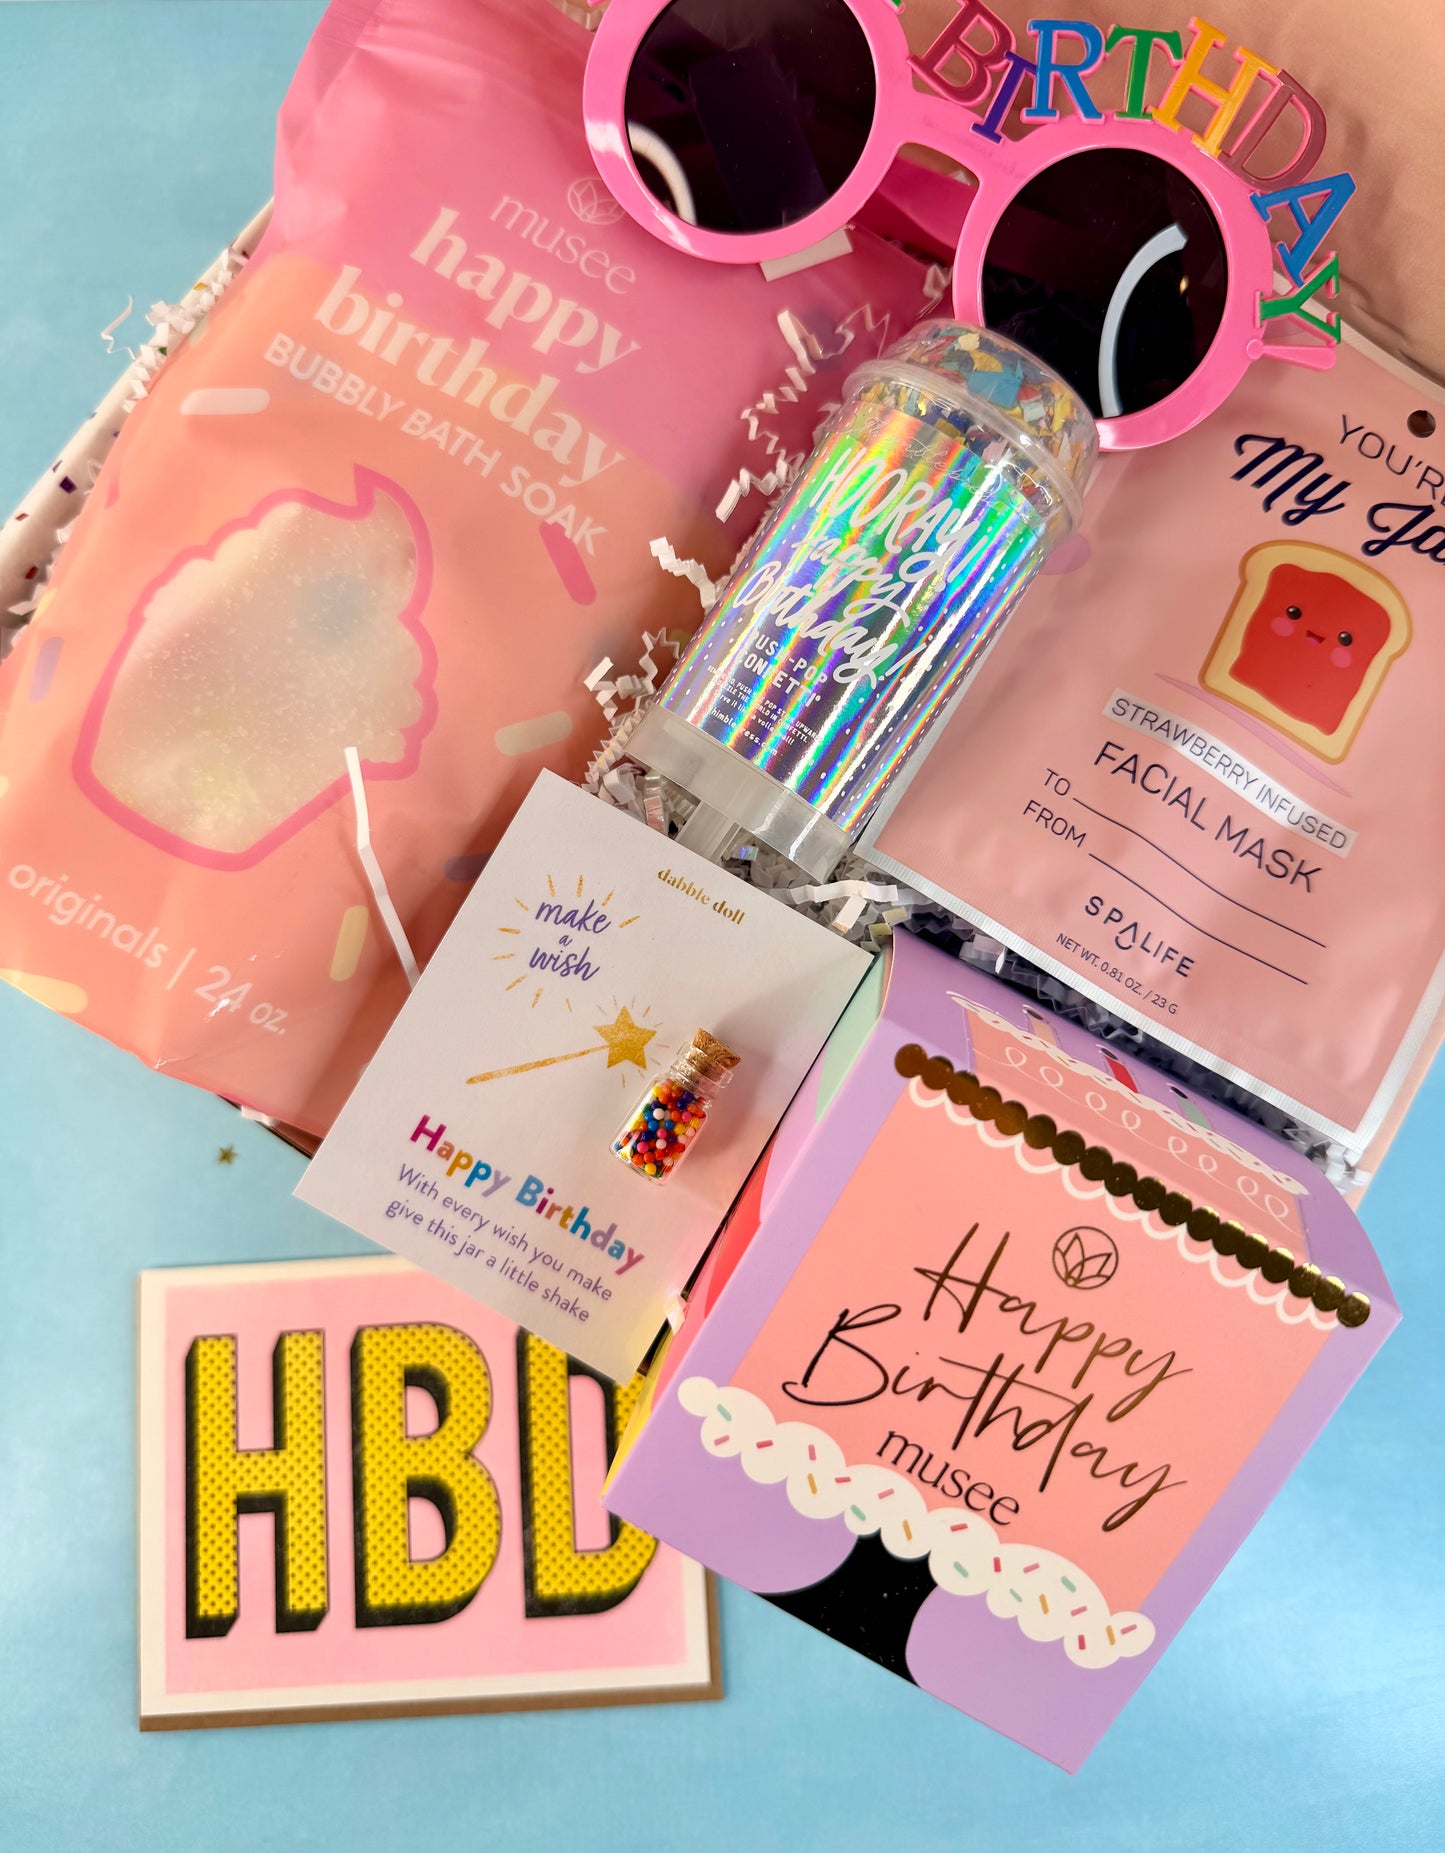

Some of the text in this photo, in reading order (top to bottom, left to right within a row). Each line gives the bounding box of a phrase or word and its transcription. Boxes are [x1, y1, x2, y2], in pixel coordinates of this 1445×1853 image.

[410, 207, 641, 373] happy
[489, 195, 636, 295] musee
[314, 264, 625, 488] birthday
[264, 332, 608, 556] BUBBLY BATH SOAK
[1230, 434, 1351, 526] My
[1340, 414, 1445, 507] YOU'R
[1023, 800, 1087, 848] FROM
[1044, 768, 1072, 797] TO
[1094, 741, 1322, 893] FACIAL MASK
[1111, 698, 1348, 850] STRAWBERRY INFUSED
[9, 864, 168, 968] originals
[195, 965, 253, 1012] 24
[250, 1002, 288, 1035] oz.
[535, 899, 611, 934] make
[558, 934, 573, 947] a
[657, 868, 746, 926] dabble doll
[529, 946, 600, 981] wish
[1056, 933, 1081, 953] NET
[1080, 948, 1101, 967] WT.
[1100, 962, 1123, 982] 0.81
[1124, 977, 1142, 995] OZ.
[1151, 994, 1167, 1008] 23
[1168, 1003, 1178, 1015] G
[398, 1163, 613, 1301] With every wish you make
[410, 1114, 645, 1276] Happy Birthday
[385, 1199, 590, 1322] give this jar a little shake
[913, 1222, 1194, 1422] Happy
[781, 1303, 1188, 1533] Birthday
[876, 1430, 1020, 1526] musee
[185, 1321, 659, 1640] HBD
